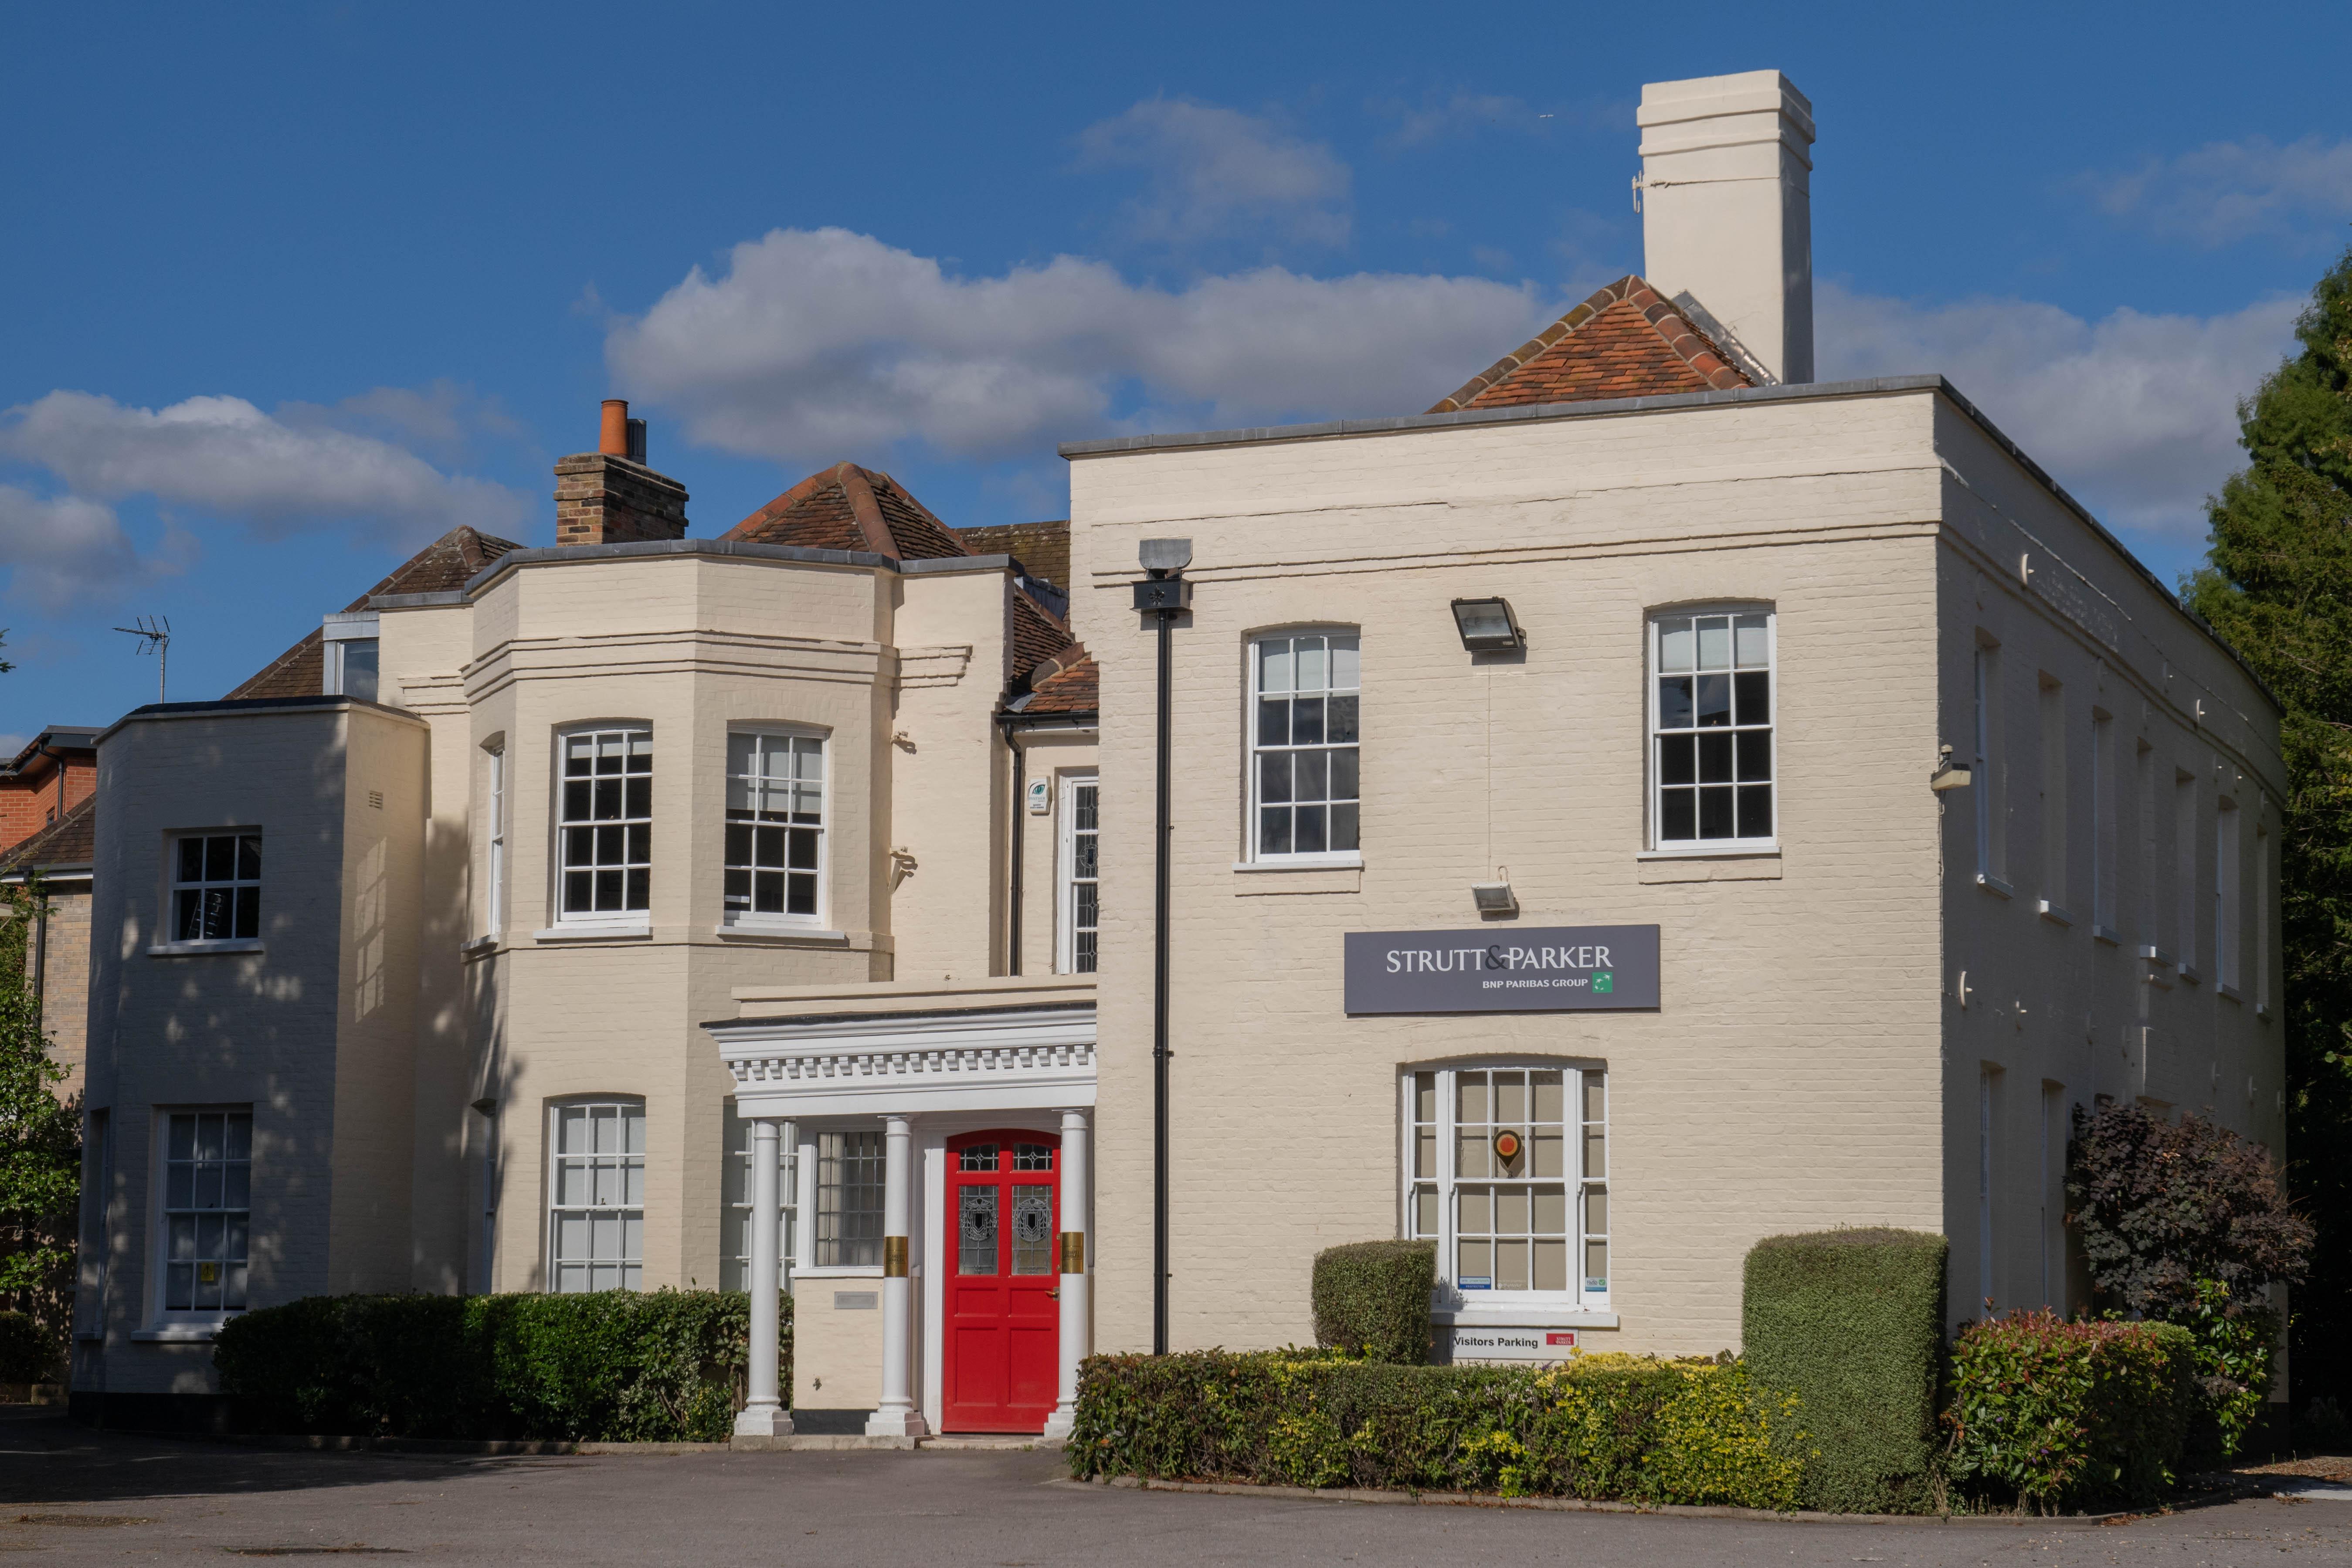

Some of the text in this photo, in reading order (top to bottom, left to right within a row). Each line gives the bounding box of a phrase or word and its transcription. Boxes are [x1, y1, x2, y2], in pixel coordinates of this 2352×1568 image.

[1506, 980, 1549, 988] PARIBAS
[1552, 979, 1588, 987] GROUP
[1454, 1337, 1538, 1349] Visitors Parking
